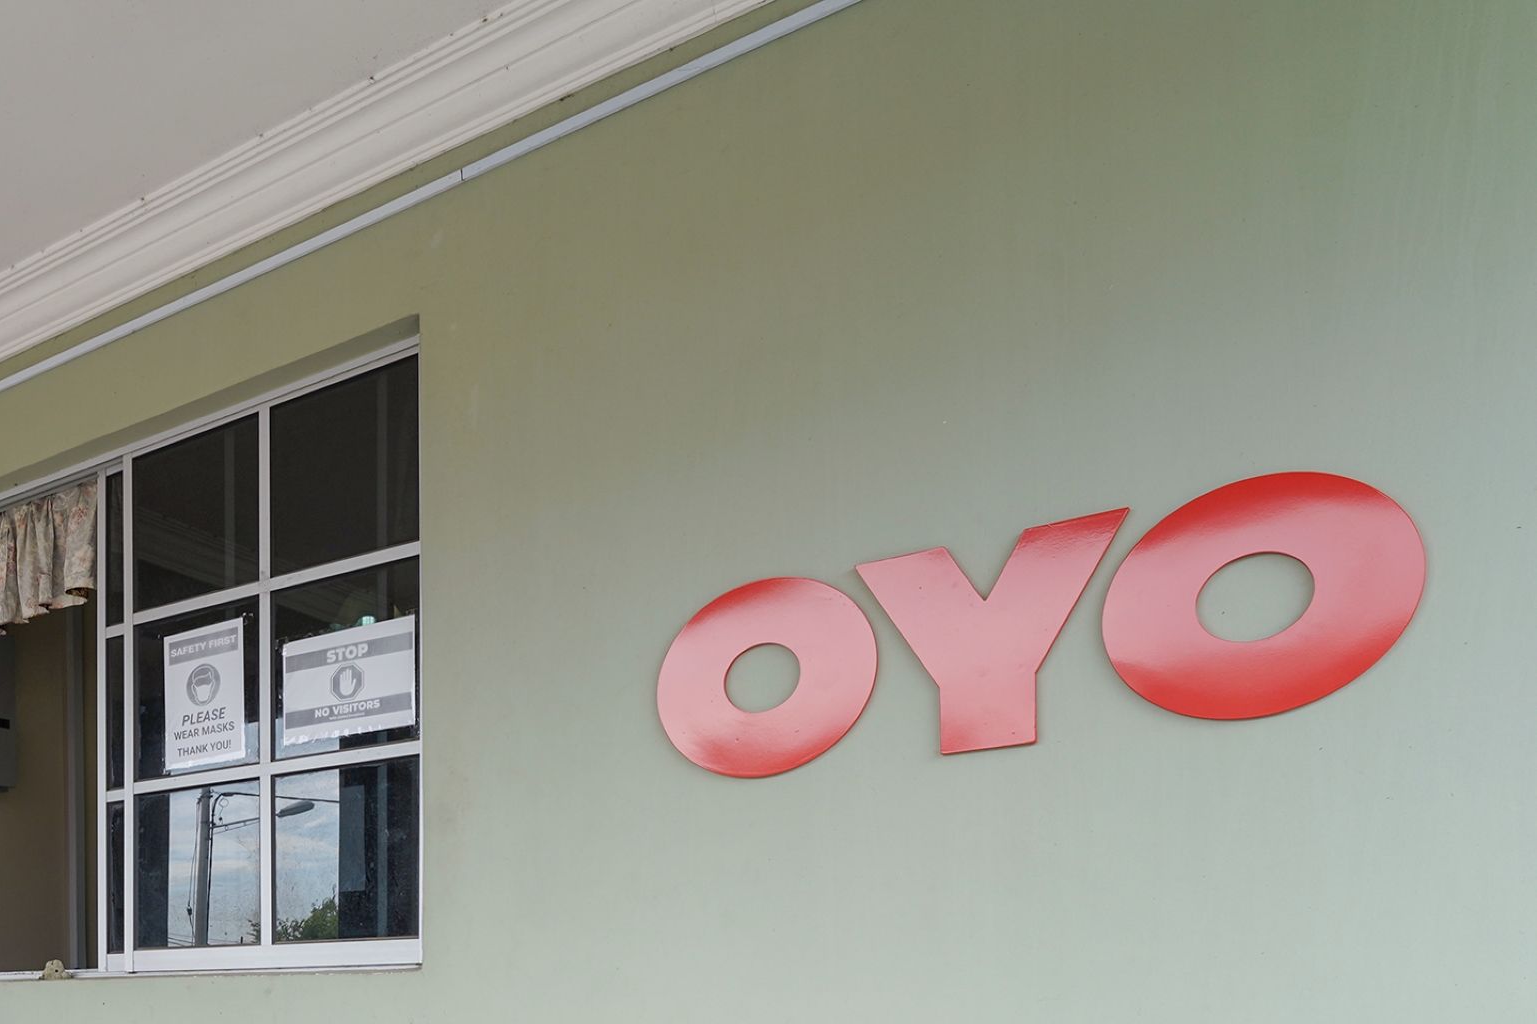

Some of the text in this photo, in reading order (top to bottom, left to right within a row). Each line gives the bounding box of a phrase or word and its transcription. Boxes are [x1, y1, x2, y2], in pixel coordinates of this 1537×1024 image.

[656, 470, 1427, 779] OYO
[170, 634, 237, 657] SAFETY FIRST
[326, 643, 368, 663] STOP
[182, 707, 226, 726] PLEASE
[314, 707, 330, 718] NO
[332, 699, 380, 715] VISITORS
[174, 721, 235, 740] WEAR MASKS
[177, 740, 232, 757] THANK YOU!
